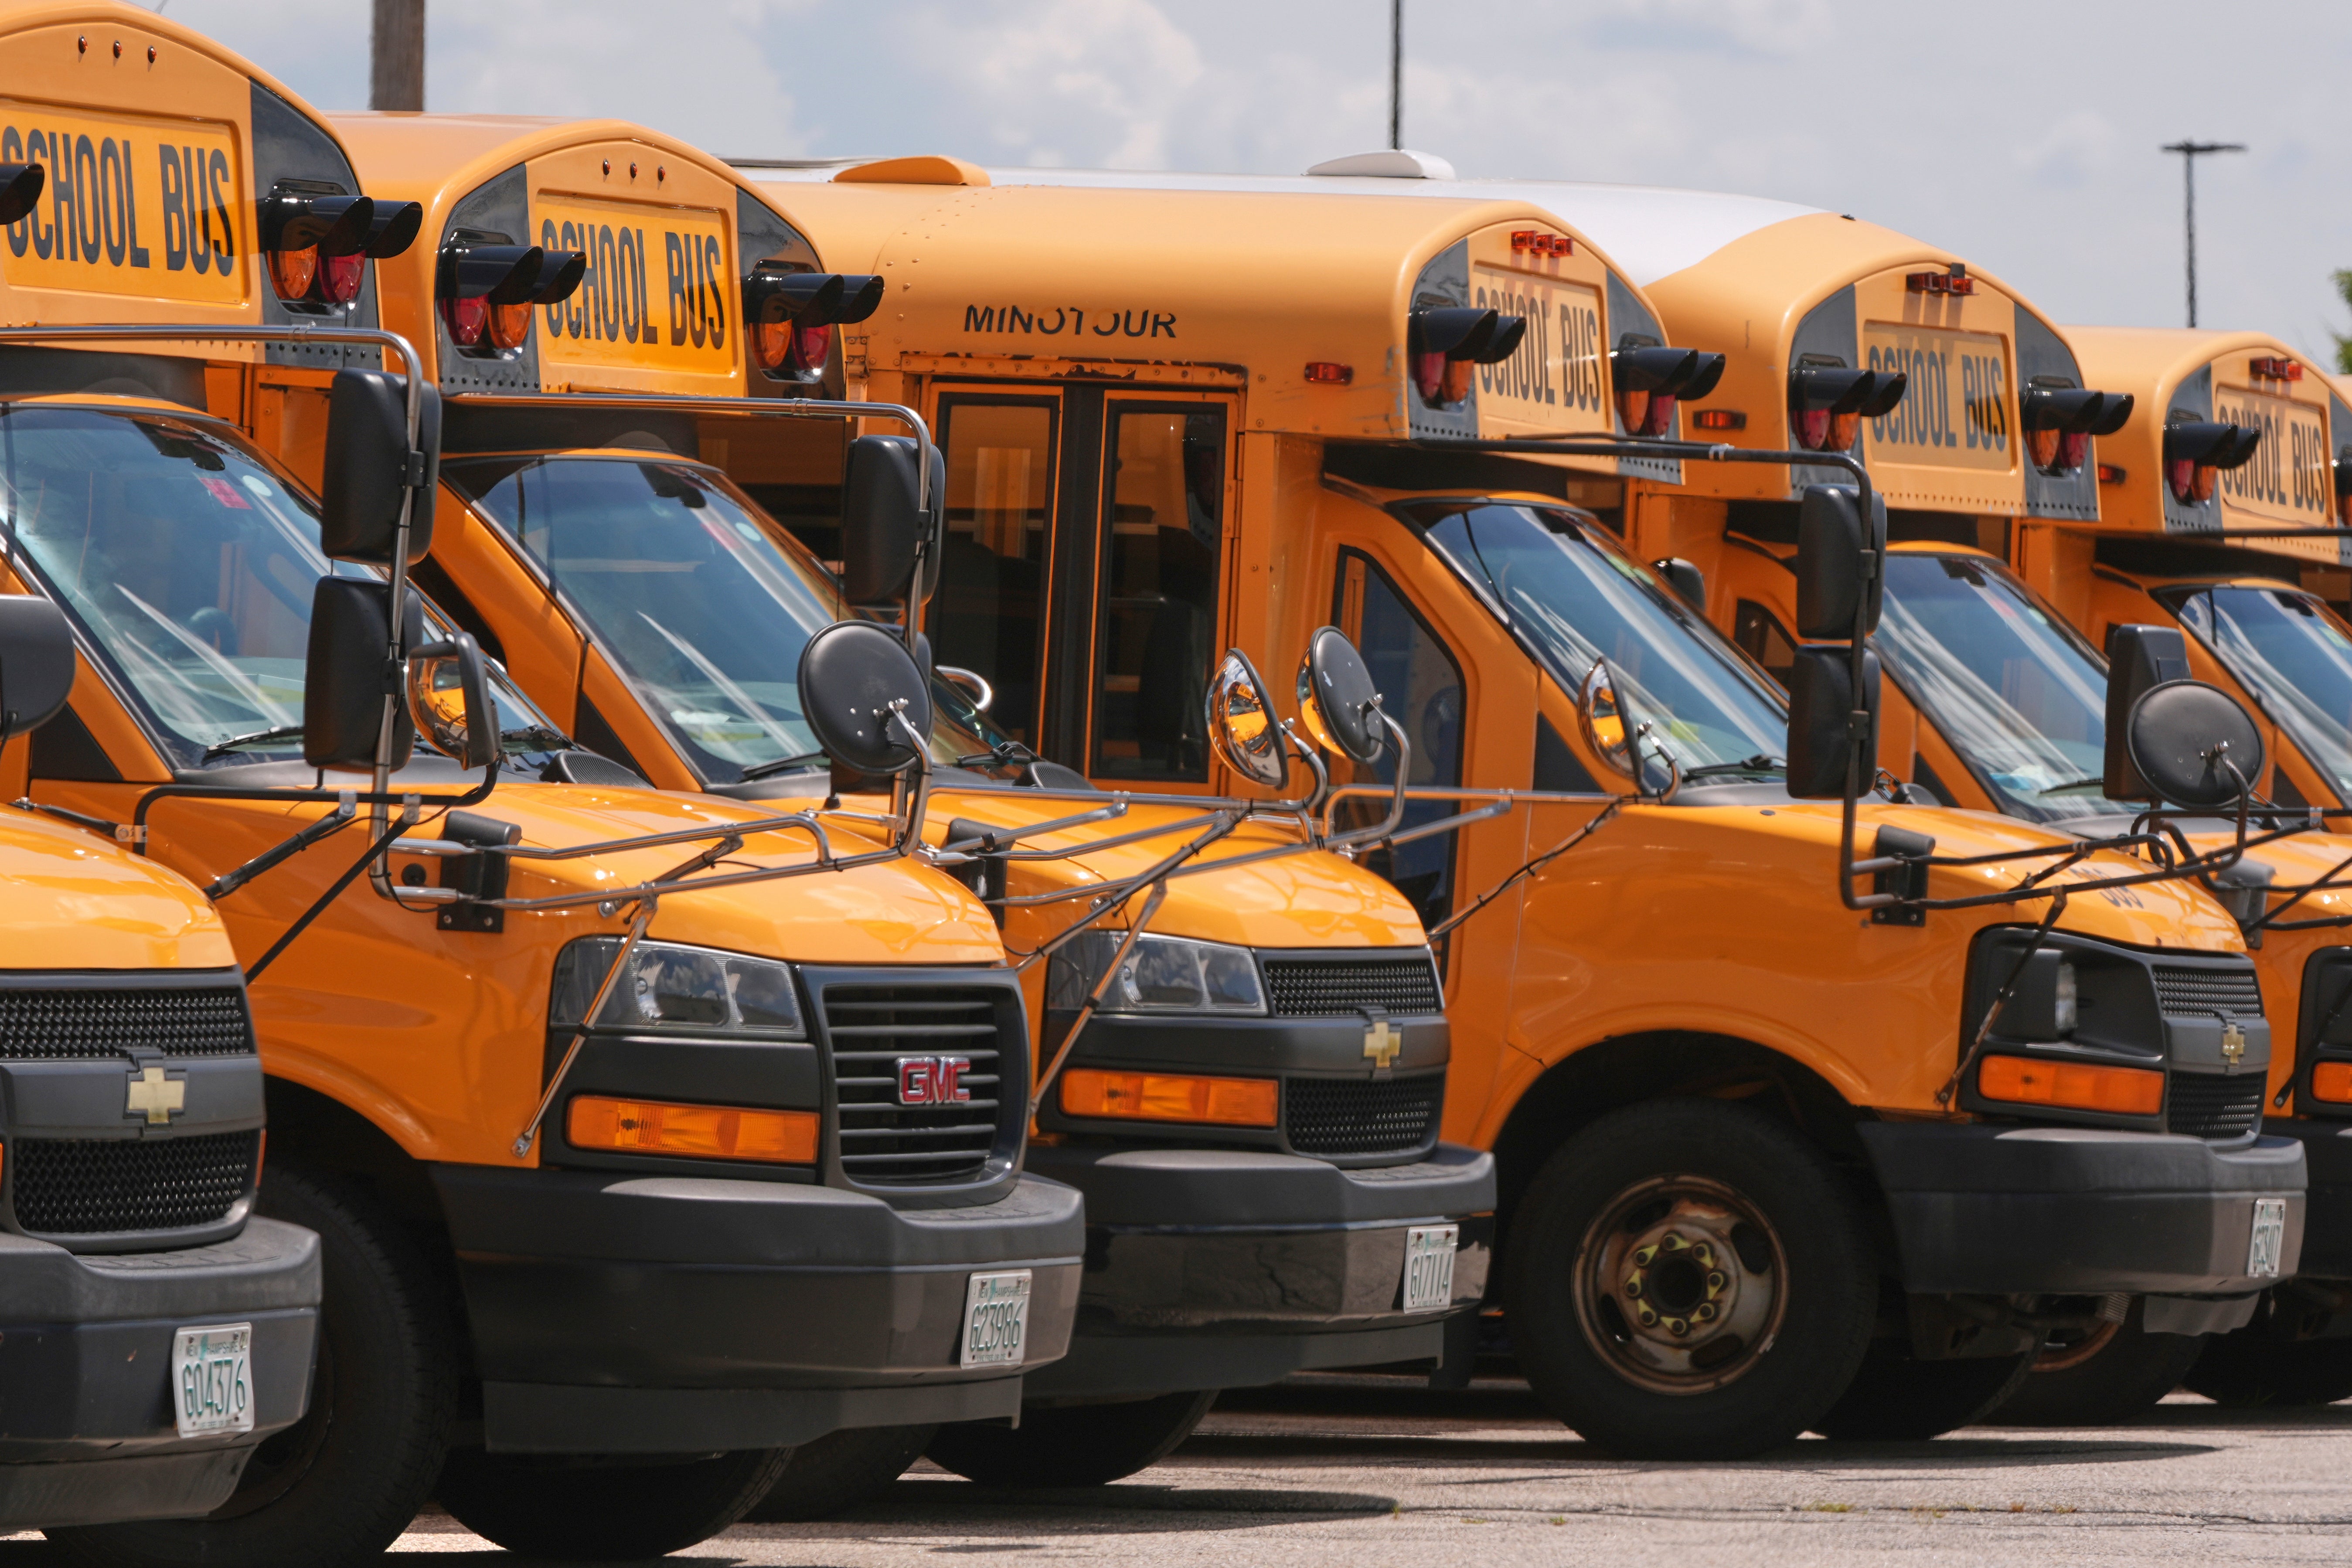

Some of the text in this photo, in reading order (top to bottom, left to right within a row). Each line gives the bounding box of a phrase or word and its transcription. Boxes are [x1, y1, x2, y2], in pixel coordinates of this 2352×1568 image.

[2, 126, 234, 277] SCHOOL BUS
[541, 219, 725, 350] SCHOOL BUS
[964, 304, 1177, 338] MINOTOUR
[1560, 303, 1600, 413] BUS
[1961, 354, 2006, 452] BUS
[2291, 420, 2324, 514] BUS
[895, 1057, 970, 1105] GMC
[1411, 1252, 1452, 1299] G17114
[970, 1301, 1024, 1352] G23986
[183, 1357, 245, 1418] G04376
